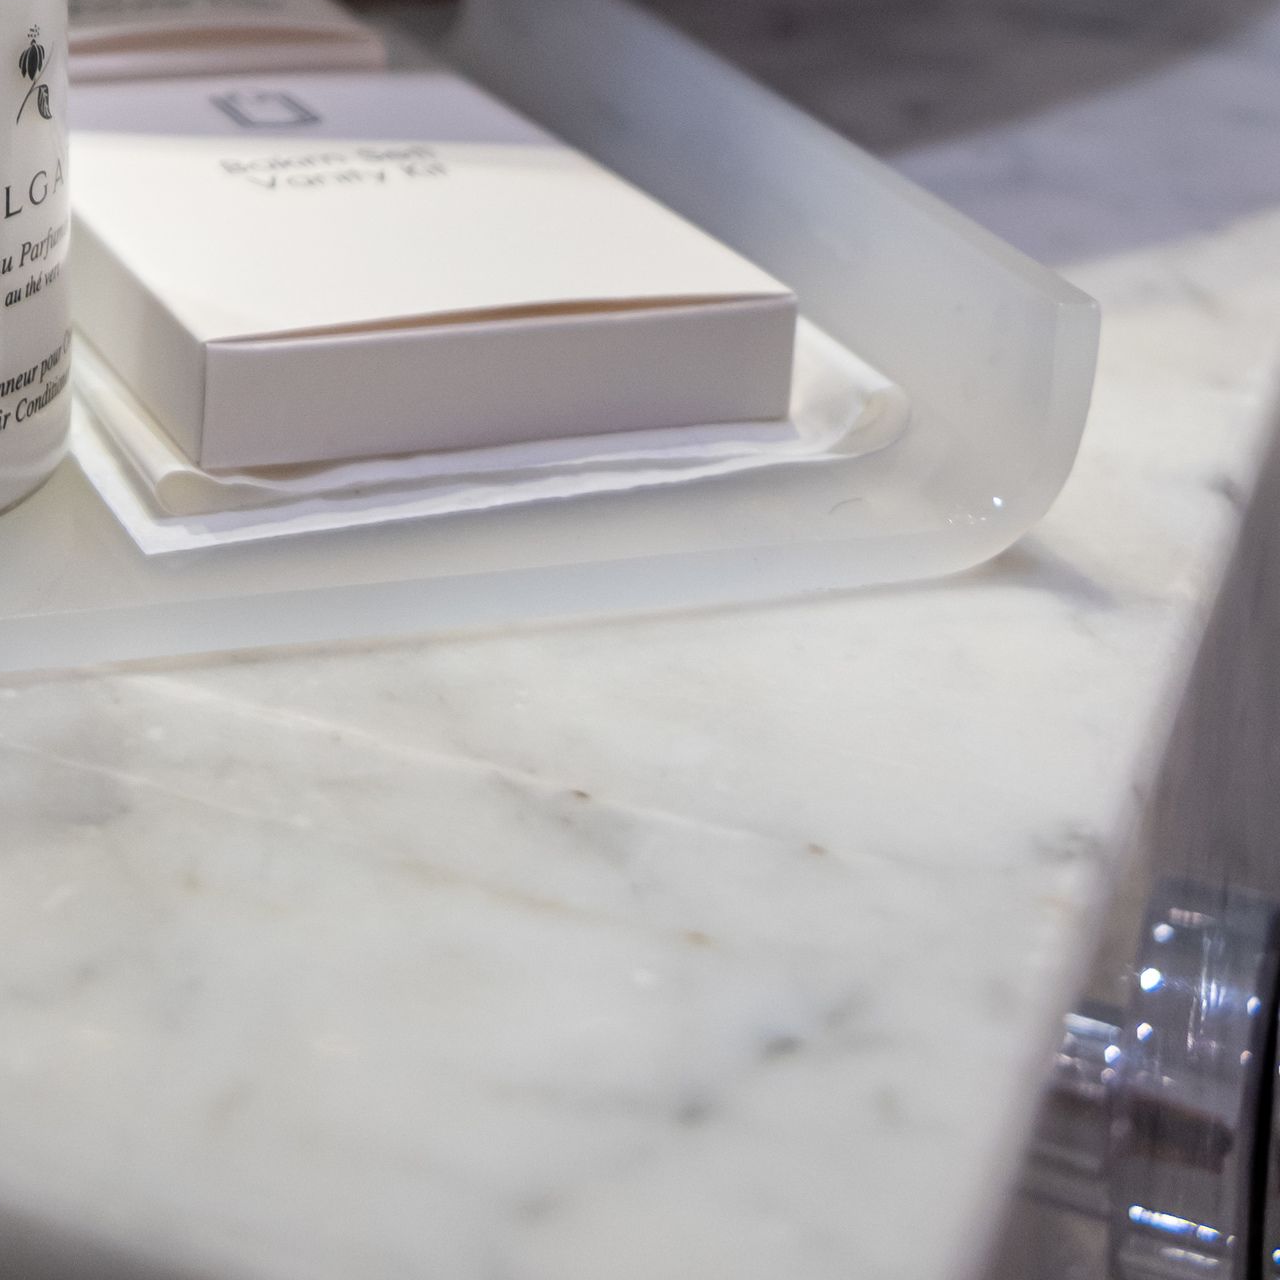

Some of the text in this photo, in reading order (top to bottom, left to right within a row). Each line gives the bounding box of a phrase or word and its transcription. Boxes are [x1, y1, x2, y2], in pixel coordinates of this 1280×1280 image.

[4, 286, 22, 307] au
[25, 270, 42, 298] thé
[39, 345, 62, 383] pour
